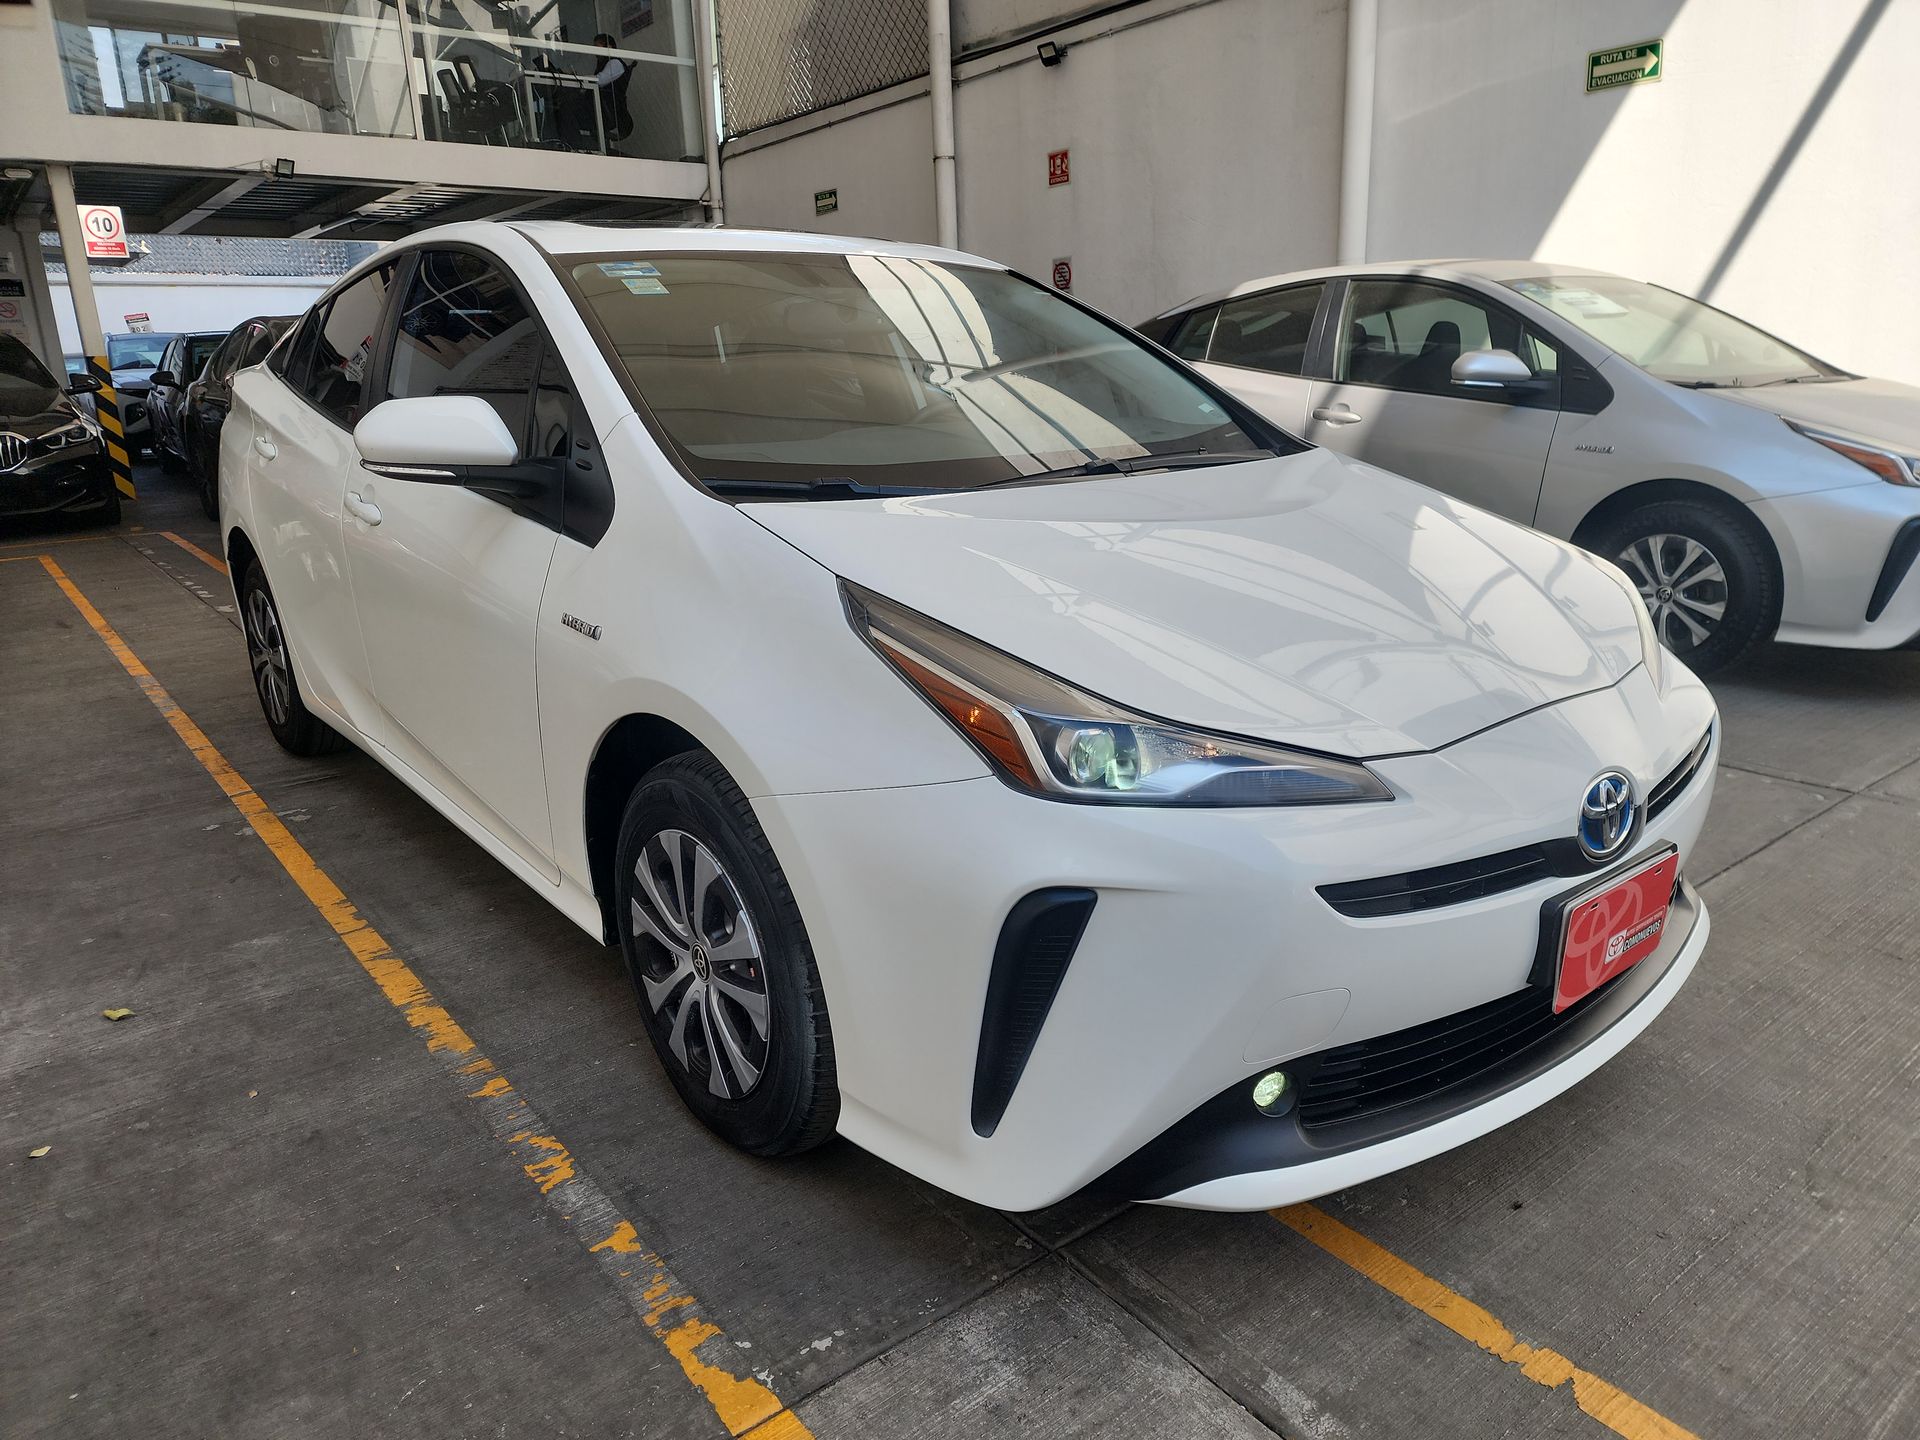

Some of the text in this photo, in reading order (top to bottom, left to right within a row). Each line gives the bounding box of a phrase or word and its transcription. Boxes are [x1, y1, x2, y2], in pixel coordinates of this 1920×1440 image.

[1600, 49, 1638, 64] RUTA DE
[1591, 69, 1642, 87] EVACUACION
[92, 216, 113, 232] 10
[560, 611, 599, 640] HYBRID
